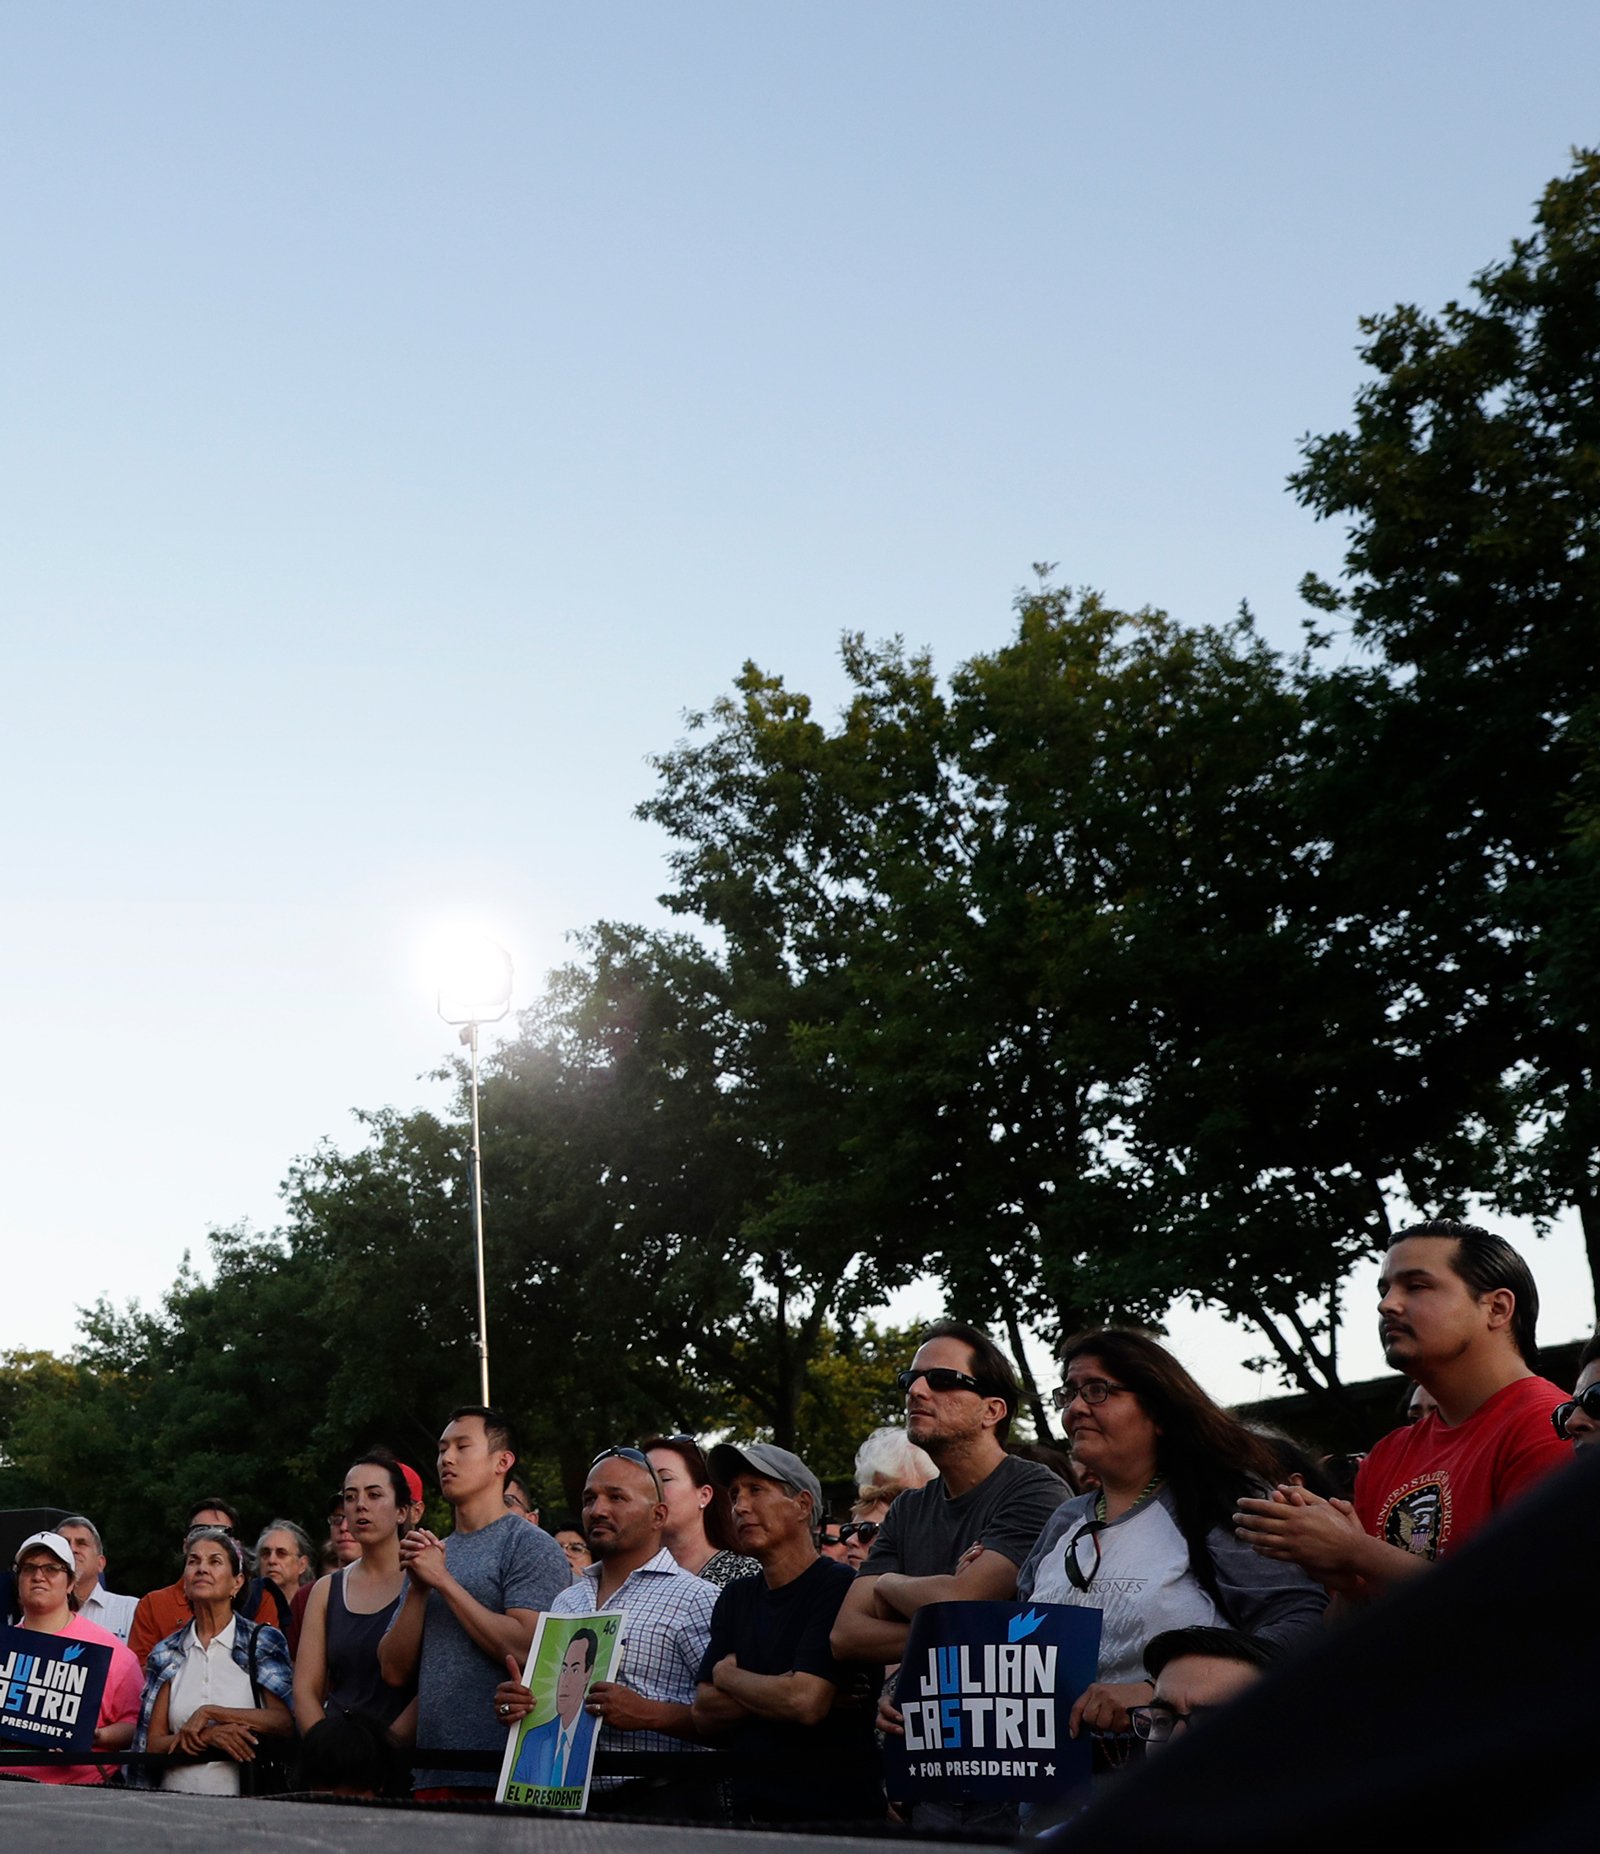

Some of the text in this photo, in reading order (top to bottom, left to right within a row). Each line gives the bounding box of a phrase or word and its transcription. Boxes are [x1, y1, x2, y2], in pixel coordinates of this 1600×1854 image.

[1376, 1483, 1409, 1527] UNITED
[602, 1619, 617, 1636] 46
[1, 1715, 64, 1738] PRESIDENT
[900, 1696, 1057, 1751] CASTRO
[920, 1760, 1039, 1777] FOR PRESIDENT
[506, 1785, 583, 1806] EL PRESIDENTE
